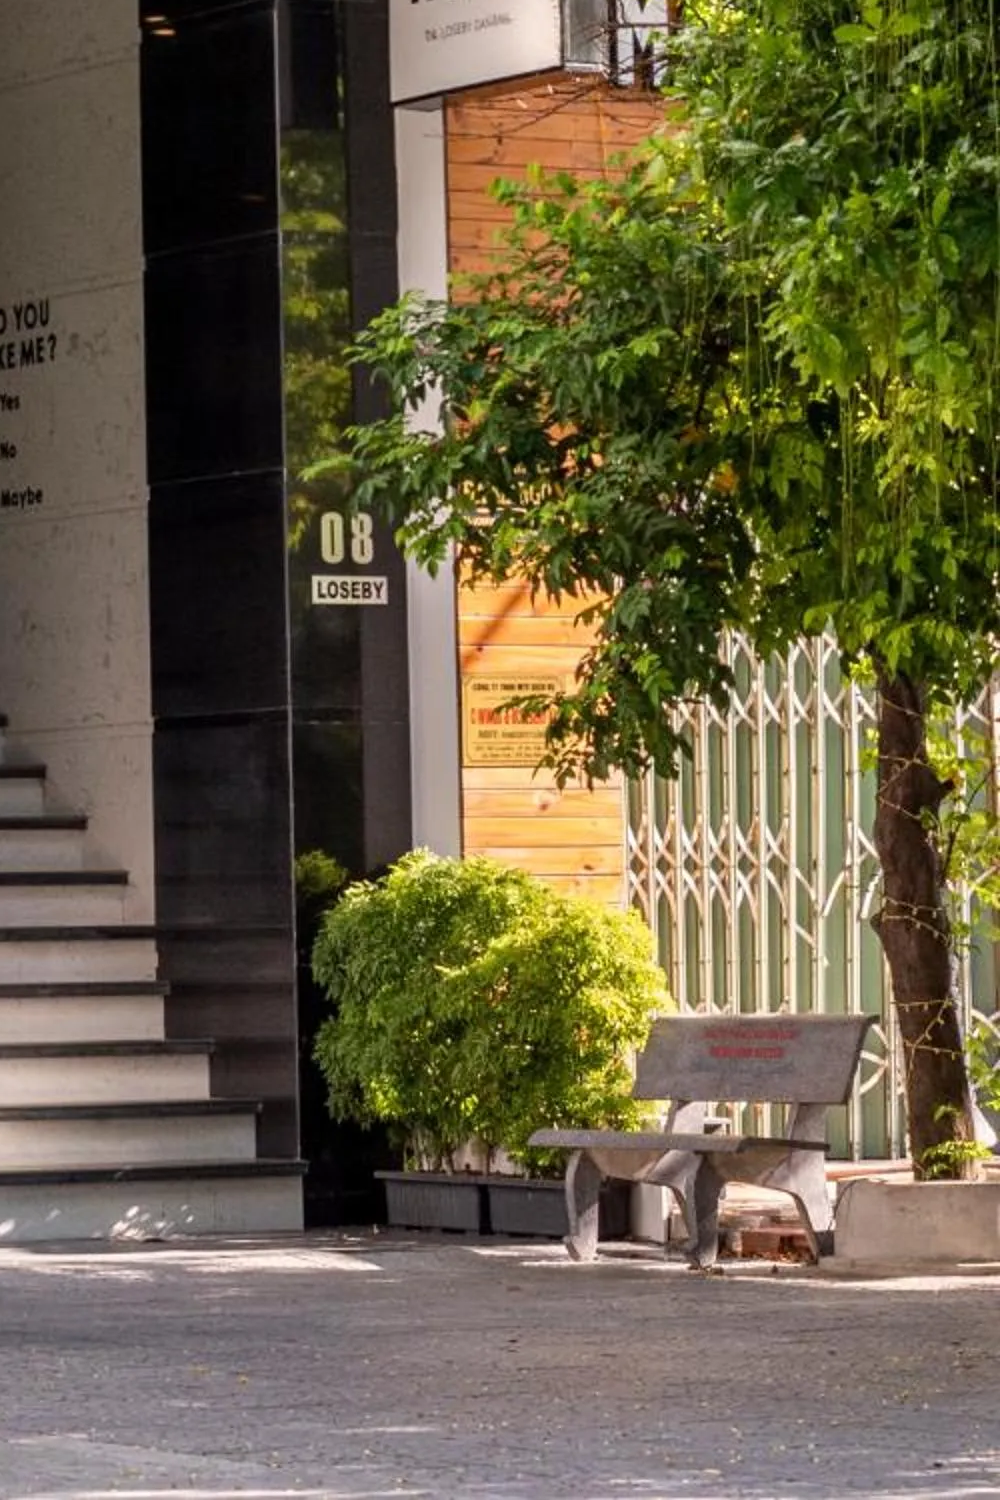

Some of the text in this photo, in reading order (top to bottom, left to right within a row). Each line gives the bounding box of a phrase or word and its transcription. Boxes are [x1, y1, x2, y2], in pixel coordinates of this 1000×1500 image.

[14, 299, 50, 331] YOU
[0, 394, 19, 411] Yes
[0, 442, 16, 459] No
[0, 487, 43, 509] Maybe
[321, 511, 374, 564] 08
[317, 581, 384, 599] LOSEBY
